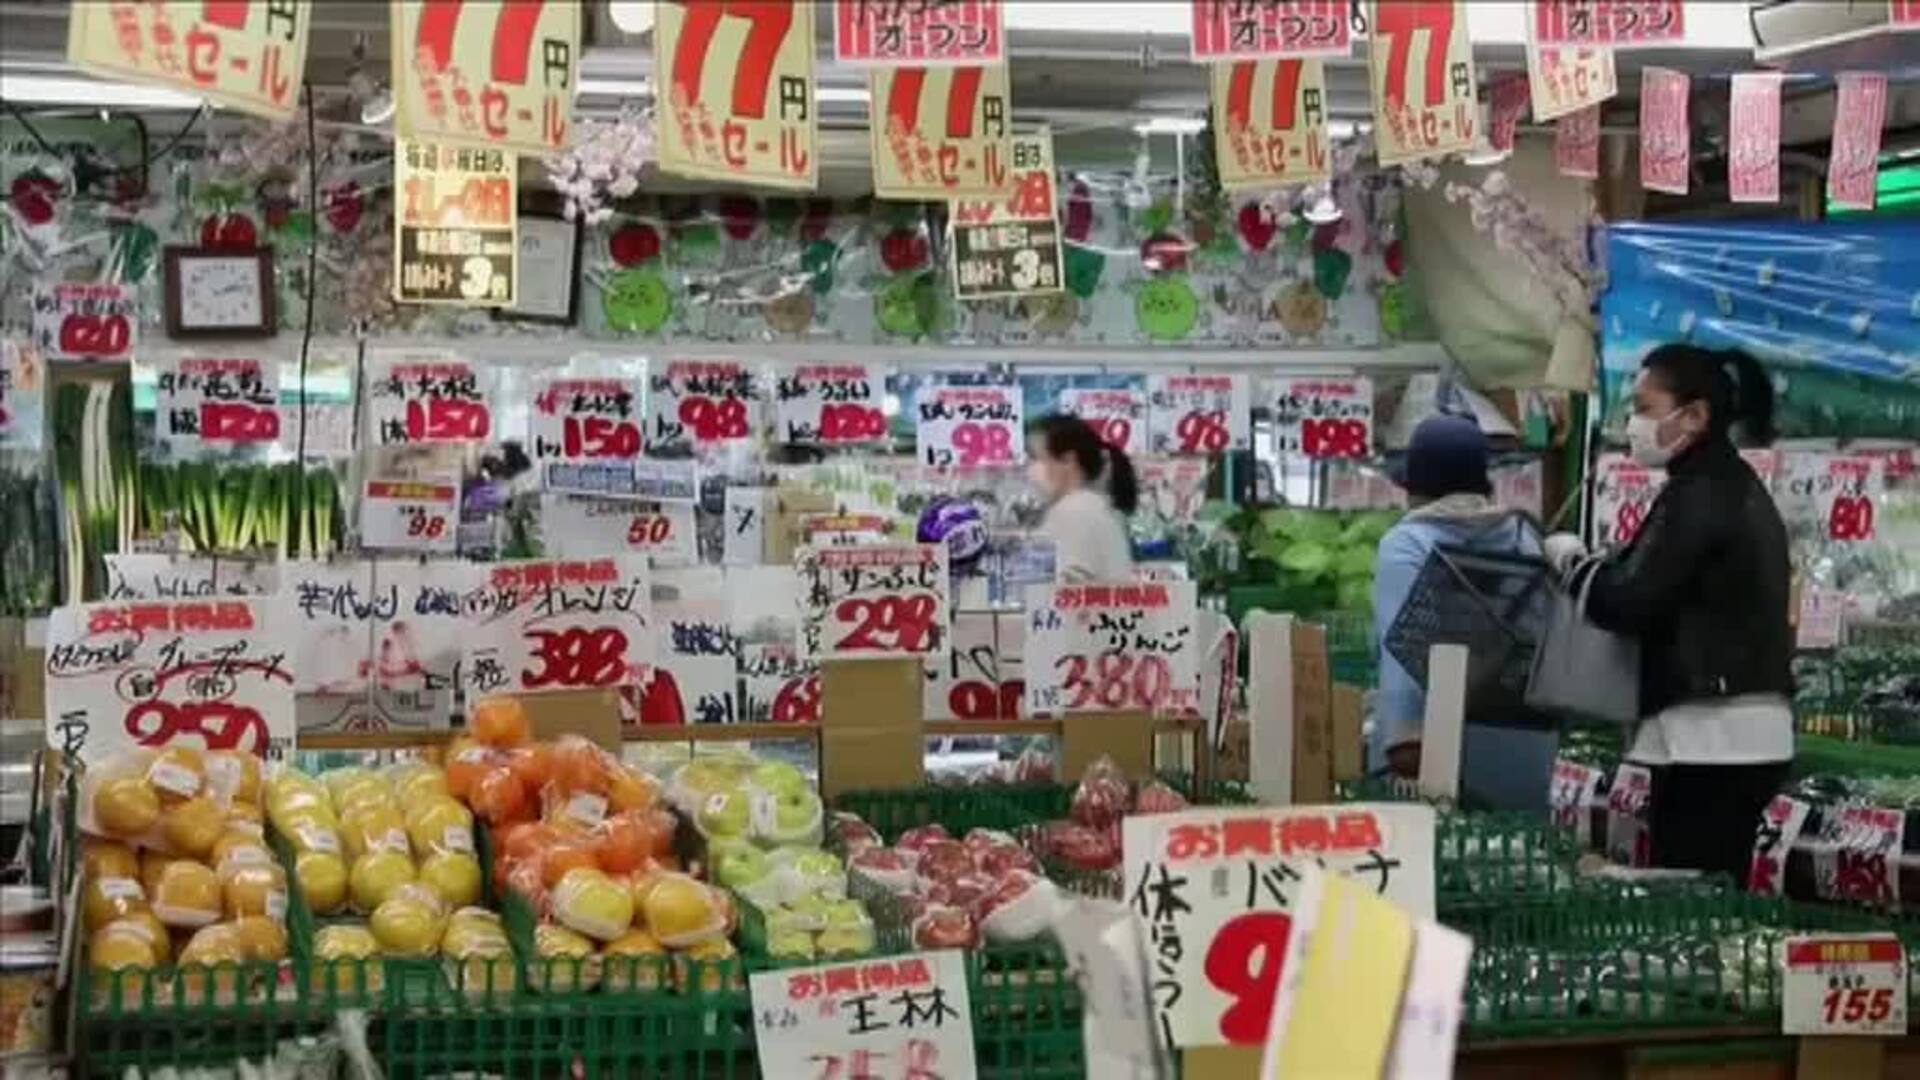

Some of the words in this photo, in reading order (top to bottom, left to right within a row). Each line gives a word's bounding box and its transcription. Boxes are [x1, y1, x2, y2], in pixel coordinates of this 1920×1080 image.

[480, 88, 568, 147] セール
[1421, 104, 1472, 146] セール
[722, 120, 807, 174] セール
[937, 141, 1006, 190] セール
[1268, 130, 1324, 173] セール
[564, 416, 641, 457] 150
[408, 515, 446, 537] 98
[628, 515, 666, 544] 50
[521, 626, 629, 687] 388
[1054, 654, 1171, 709] 380
[1166, 812, 1382, 860] お買得品
[1247, 850, 1400, 908] バナ
[840, 987, 960, 1034] 王林
[1823, 989, 1894, 1024] 155
